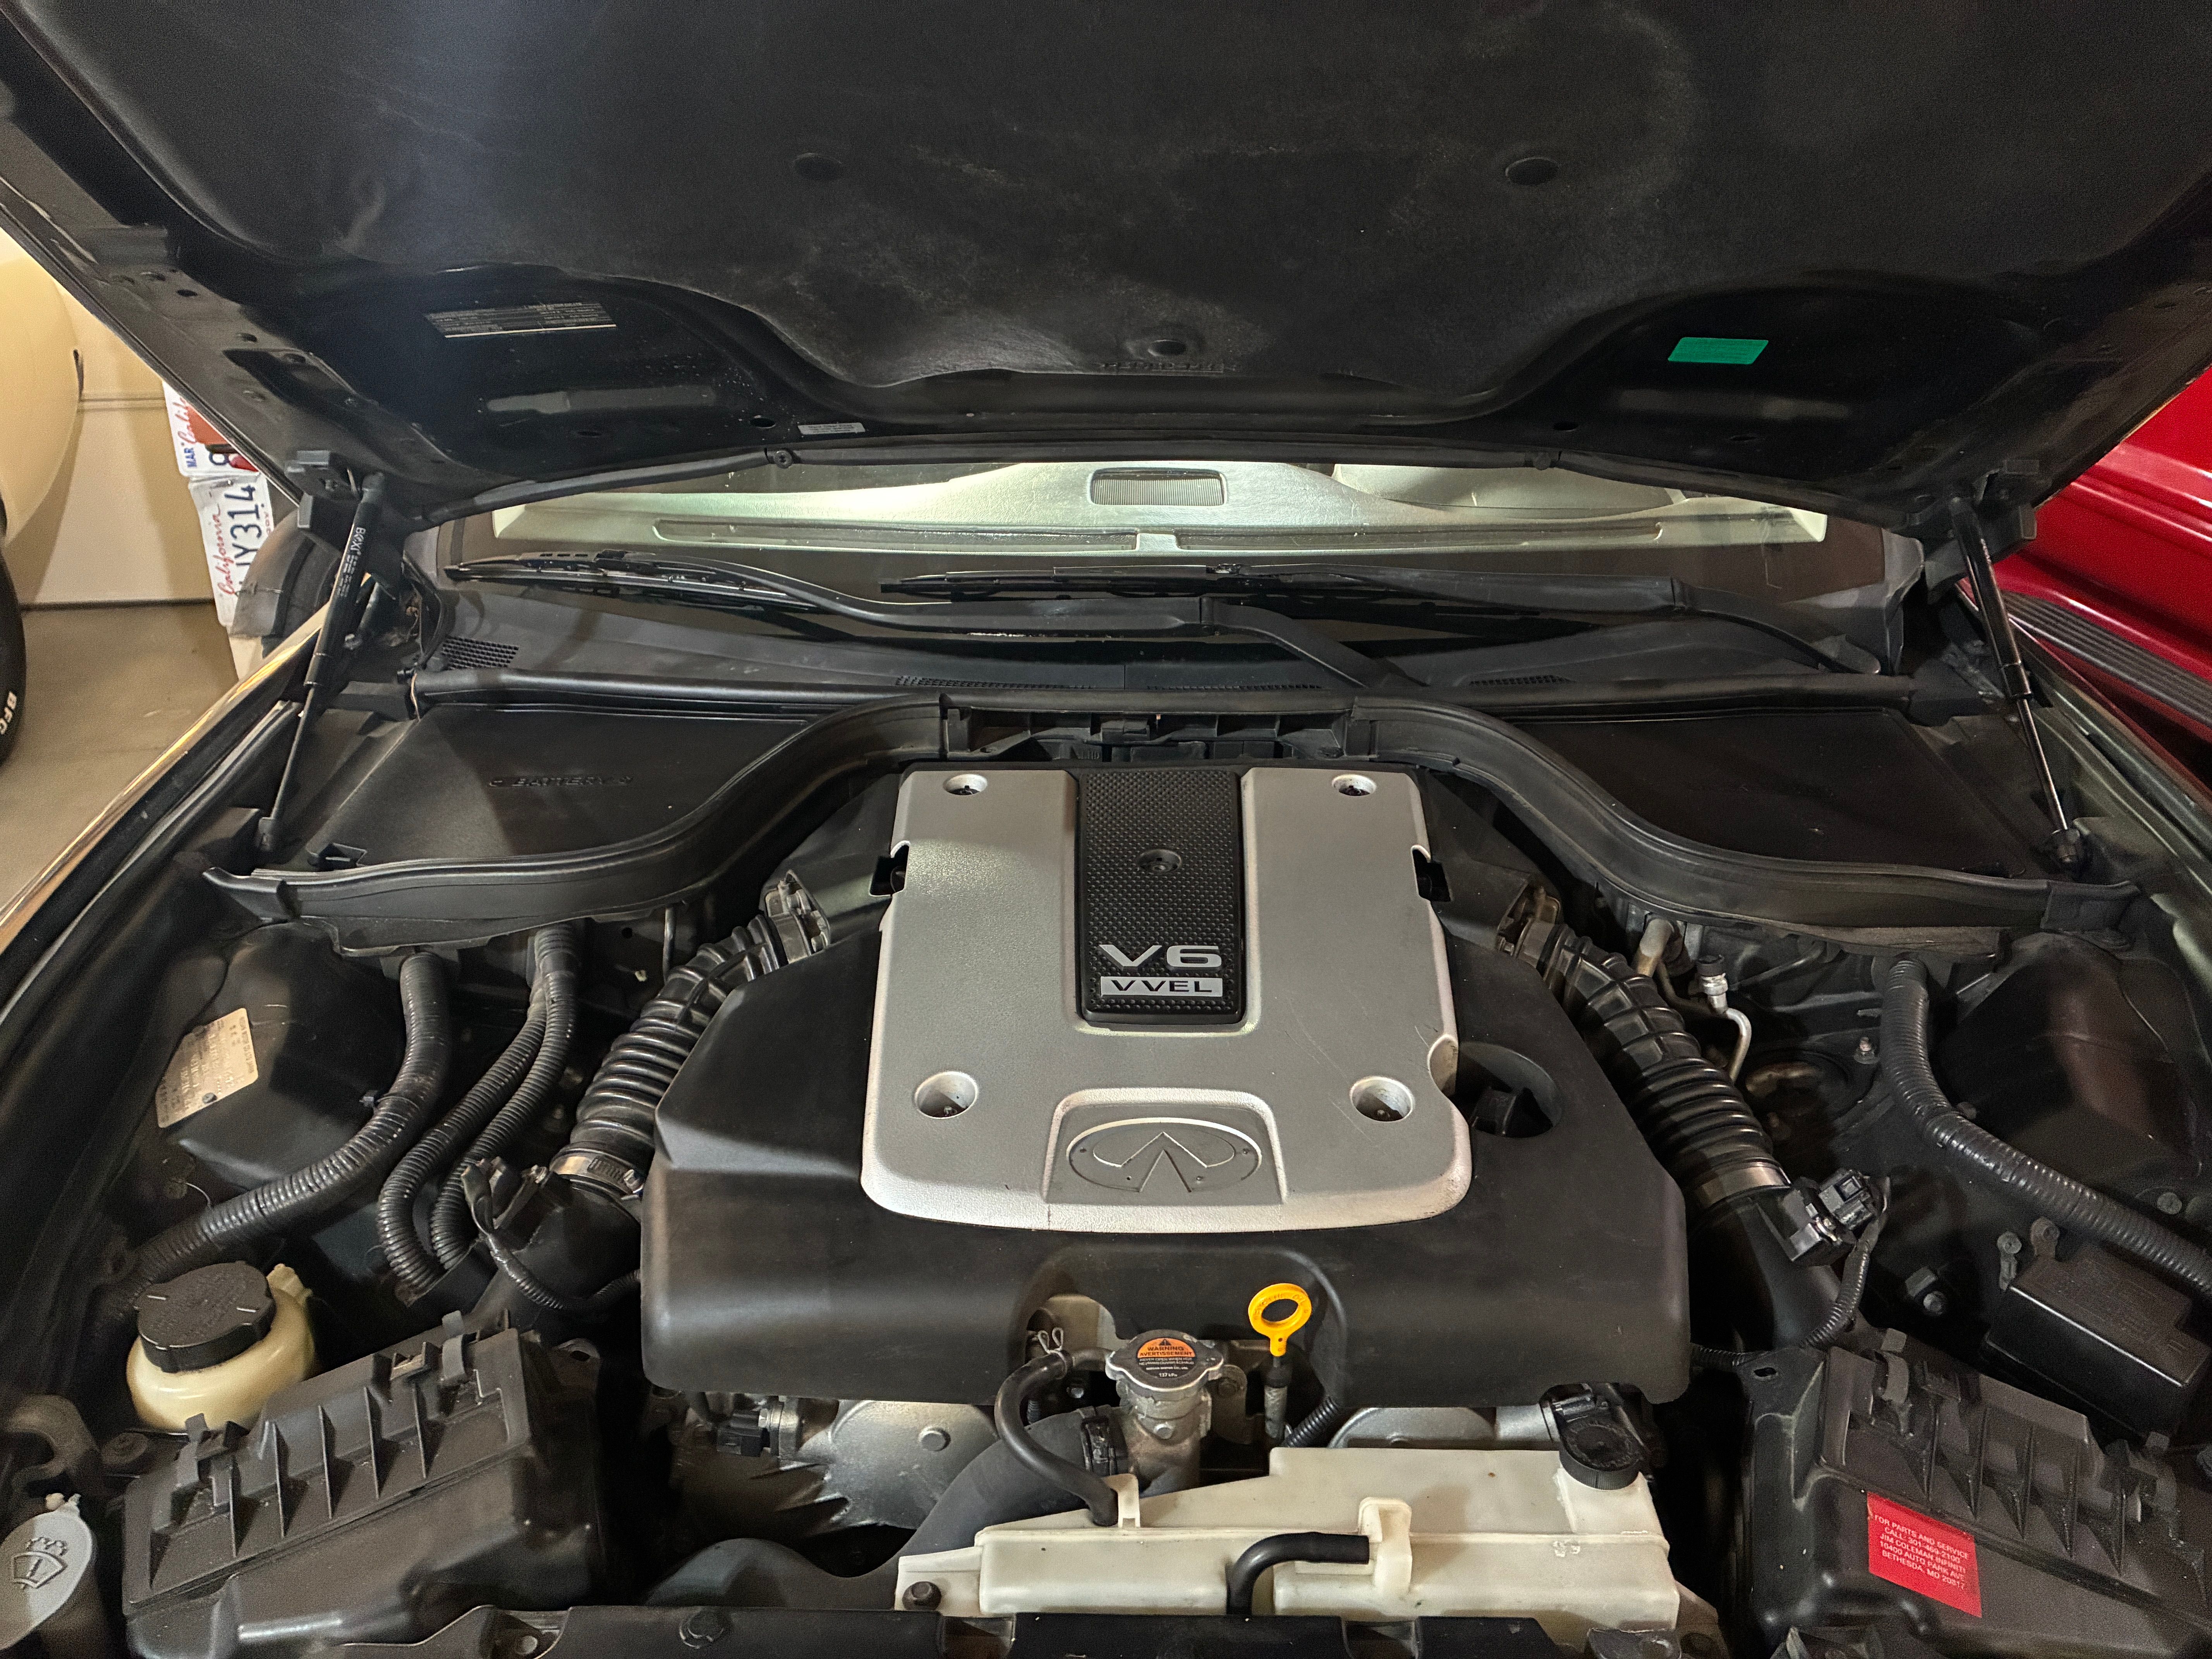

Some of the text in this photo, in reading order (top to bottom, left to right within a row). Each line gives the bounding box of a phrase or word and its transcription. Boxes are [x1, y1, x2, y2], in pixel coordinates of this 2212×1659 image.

[184, 447, 197, 467] MAR
[212, 503, 235, 595] California
[1099, 944, 1222, 969] V6
[1111, 980, 1213, 993] VVEL
[1874, 1514, 1969, 1560] FOR PARTS AND SERVICE
[1879, 1532, 1966, 1574] JIM COLEMAN INFINITI
[1904, 1551, 1925, 1565] AUTO
[1927, 1560, 1948, 1575] PARK
[1927, 1568, 1939, 1579] MD
